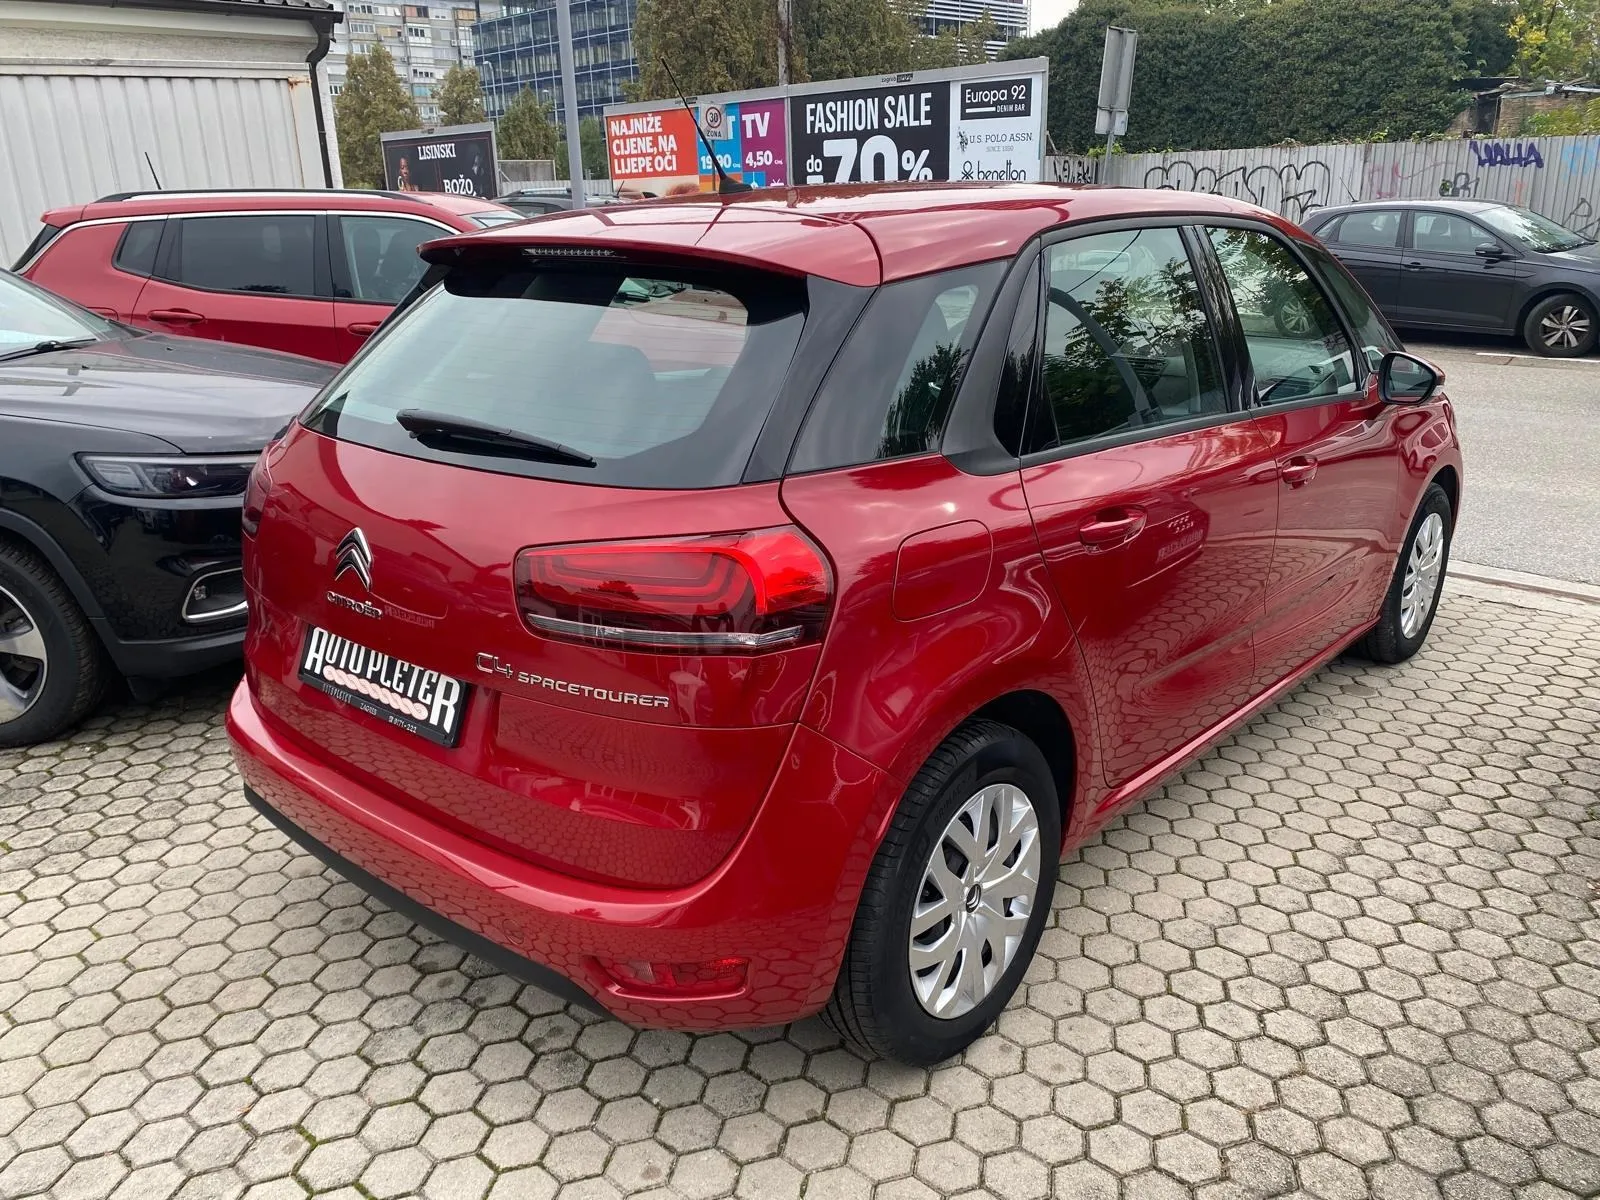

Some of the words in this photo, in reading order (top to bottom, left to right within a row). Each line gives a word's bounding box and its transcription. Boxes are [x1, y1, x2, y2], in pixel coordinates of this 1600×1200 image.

[965, 89, 1008, 104] Europa
[1011, 85, 1026, 100] 92
[709, 112, 719, 123] 30
[806, 97, 879, 134] FASHION
[884, 92, 932, 128] SALE
[997, 104, 1013, 112] DENIM
[1014, 104, 1025, 112] BAR
[611, 113, 662, 136] NAJNIŽE
[707, 130, 722, 138] ZONA
[742, 112, 770, 138] TV
[612, 135, 658, 156] CIJENE,
[658, 135, 677, 152] NA
[985, 134, 1007, 142] POLO
[418, 143, 456, 160] LISINSKI
[745, 150, 773, 168] 4,50
[614, 156, 652, 174] LIJEPE
[655, 152, 677, 172] OČI
[806, 154, 822, 173] do
[977, 160, 1026, 181] benetton
[443, 174, 477, 196] BOŽO,
[304, 627, 366, 675] AUTO
[366, 650, 461, 734] PLETER
[476, 652, 513, 679] C4
[518, 672, 669, 708] SPACETOURER
